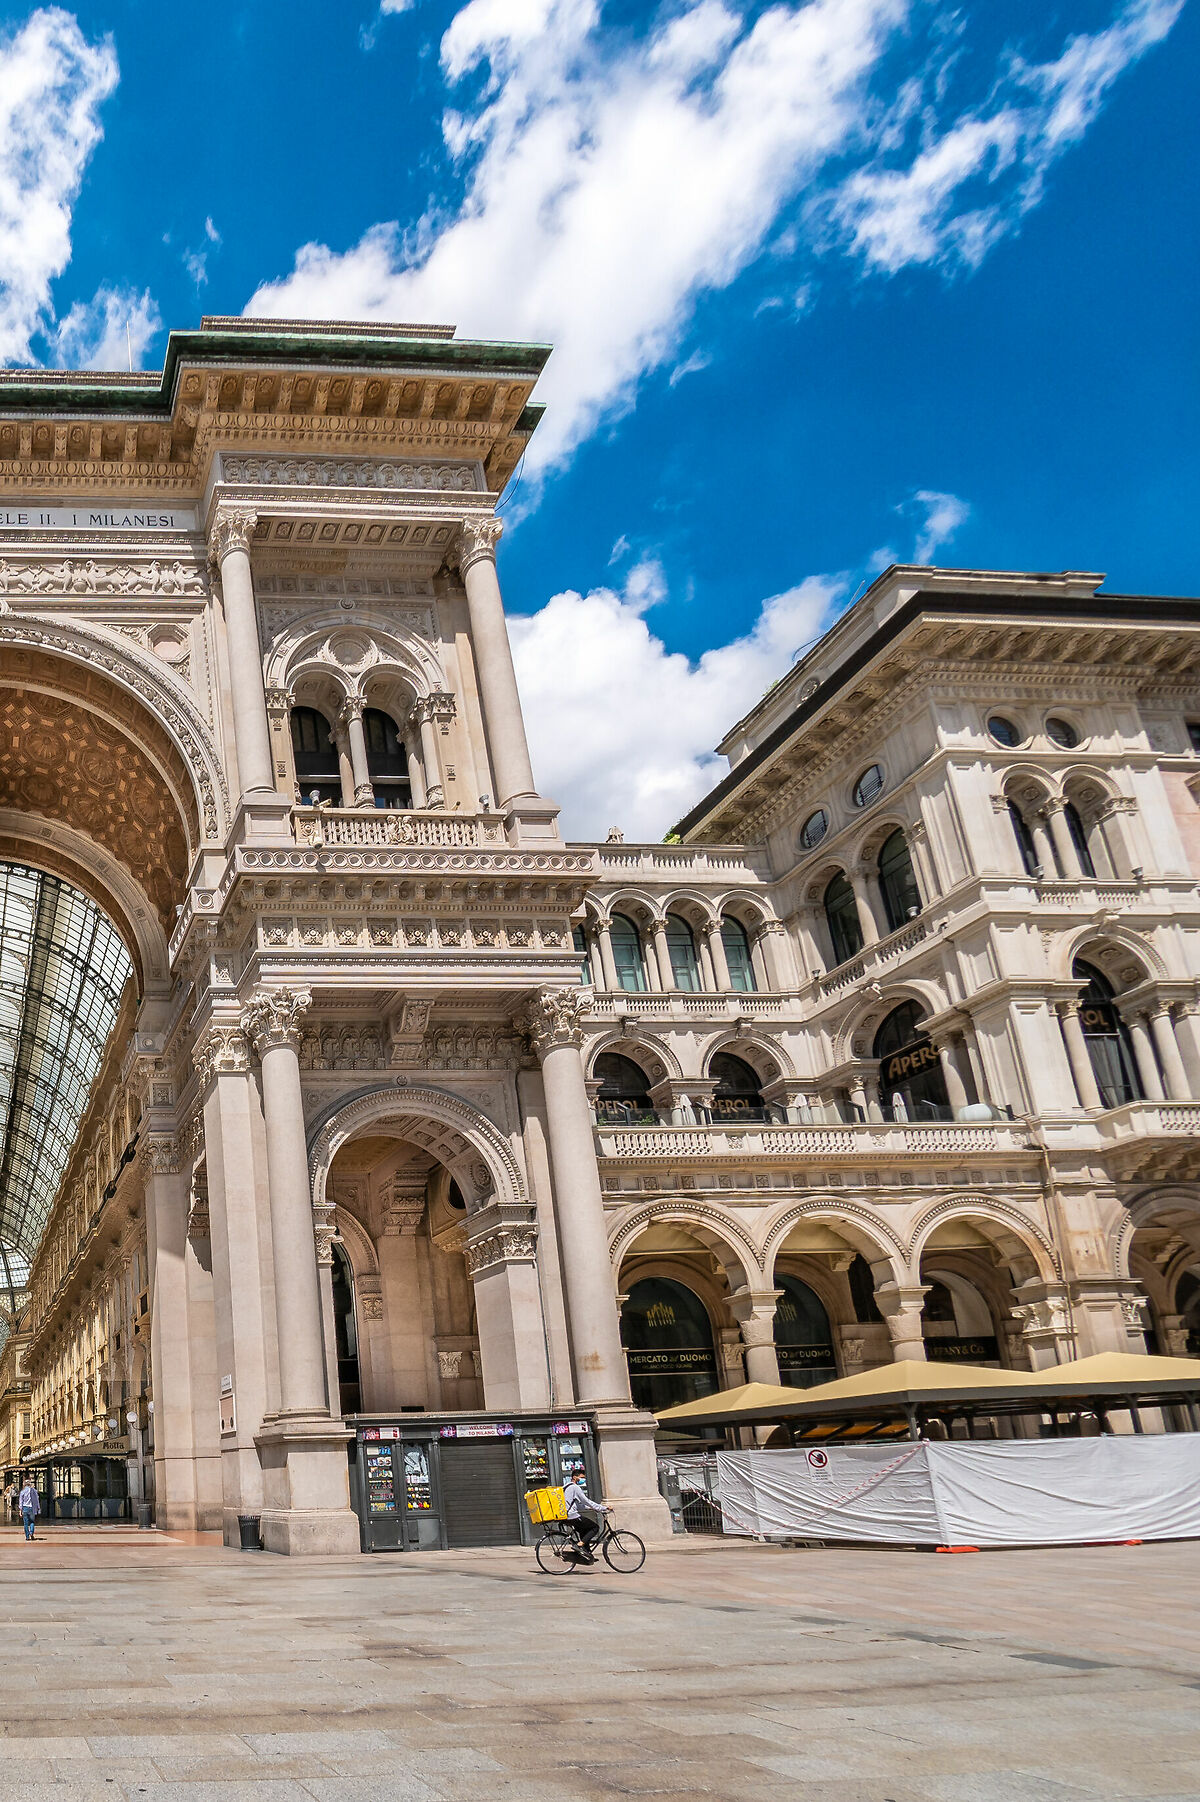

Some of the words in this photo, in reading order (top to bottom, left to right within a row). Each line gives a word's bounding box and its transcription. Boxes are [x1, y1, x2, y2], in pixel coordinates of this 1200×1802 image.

[39, 513, 56, 525] II.
[89, 514, 175, 527] MILANESI
[629, 1355, 668, 1364] MERCATO
[679, 1353, 712, 1362] DUOMO
[799, 1349, 831, 1359] DUOMO
